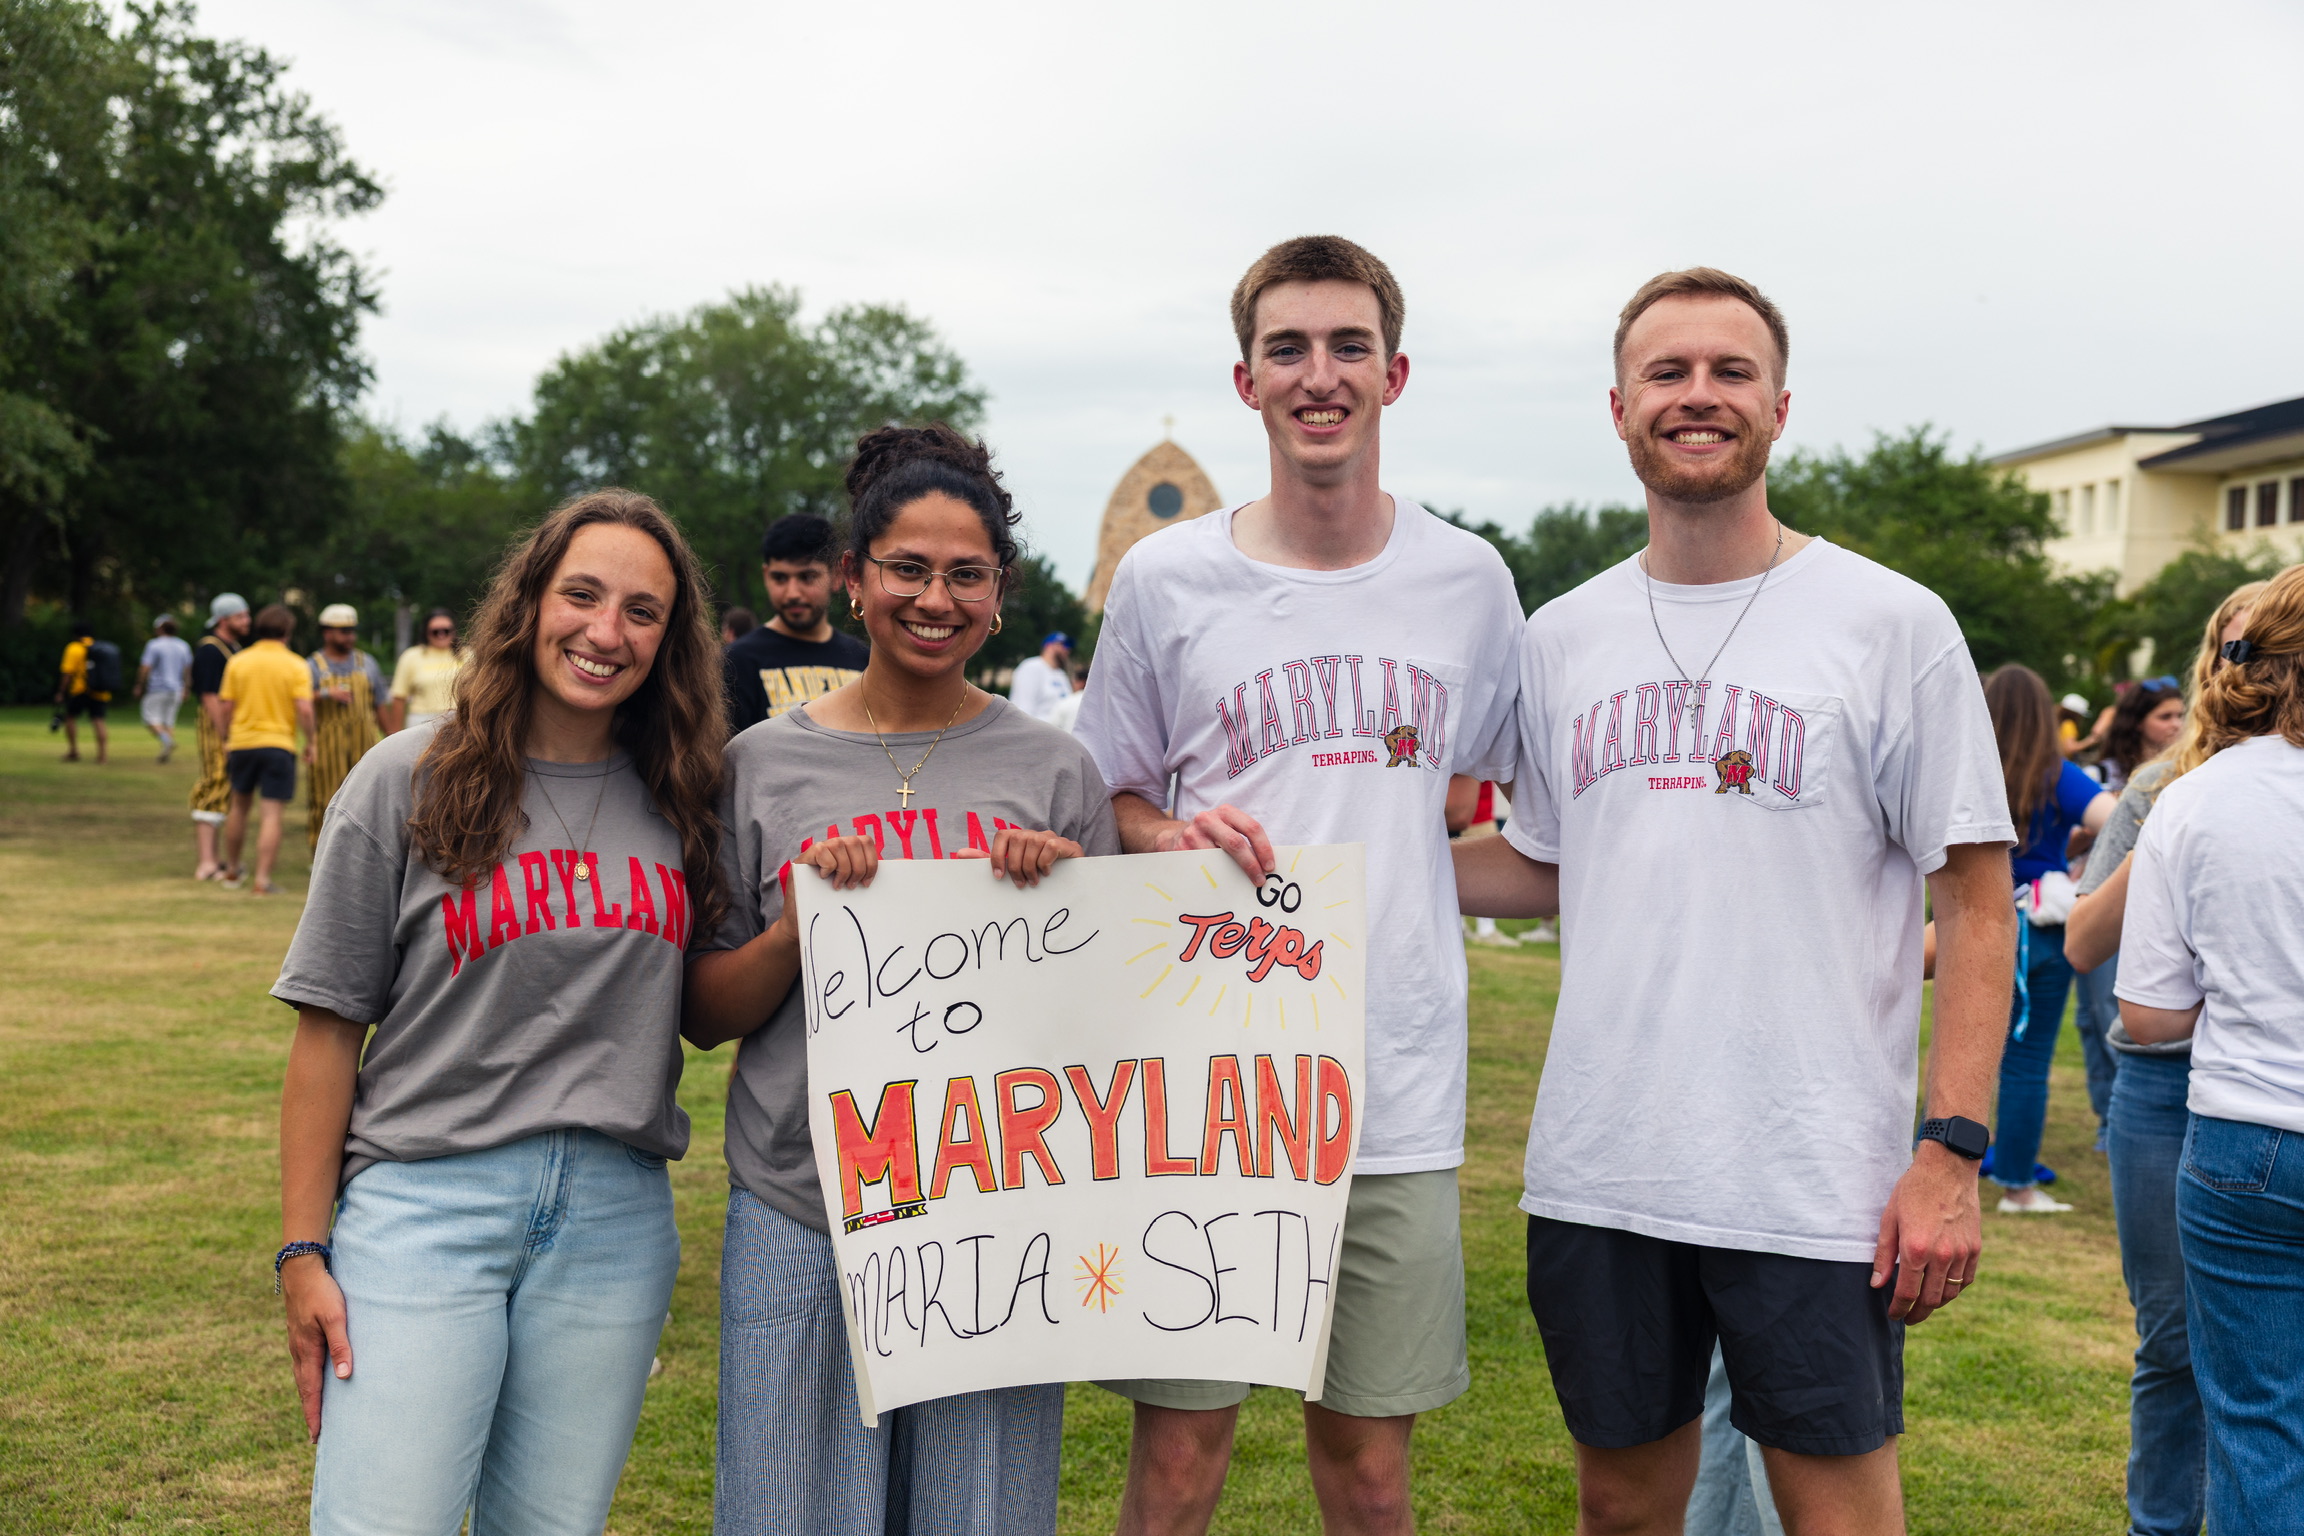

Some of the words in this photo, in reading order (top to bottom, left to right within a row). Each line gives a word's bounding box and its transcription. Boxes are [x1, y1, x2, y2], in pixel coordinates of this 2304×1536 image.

[1216, 654, 1449, 780] MARYLAND
[1572, 680, 1805, 800] MARYLAND
[441, 849, 694, 979] MARYLAN
[1179, 911, 1324, 983] Terps
[1256, 873, 1301, 913] GO
[804, 905, 1099, 1039] Welcome
[896, 1001, 983, 1053] to
[829, 1054, 1353, 1221] MARYLAND
[847, 1232, 1060, 1357] MARIA
[1143, 1211, 1339, 1342] SETH
